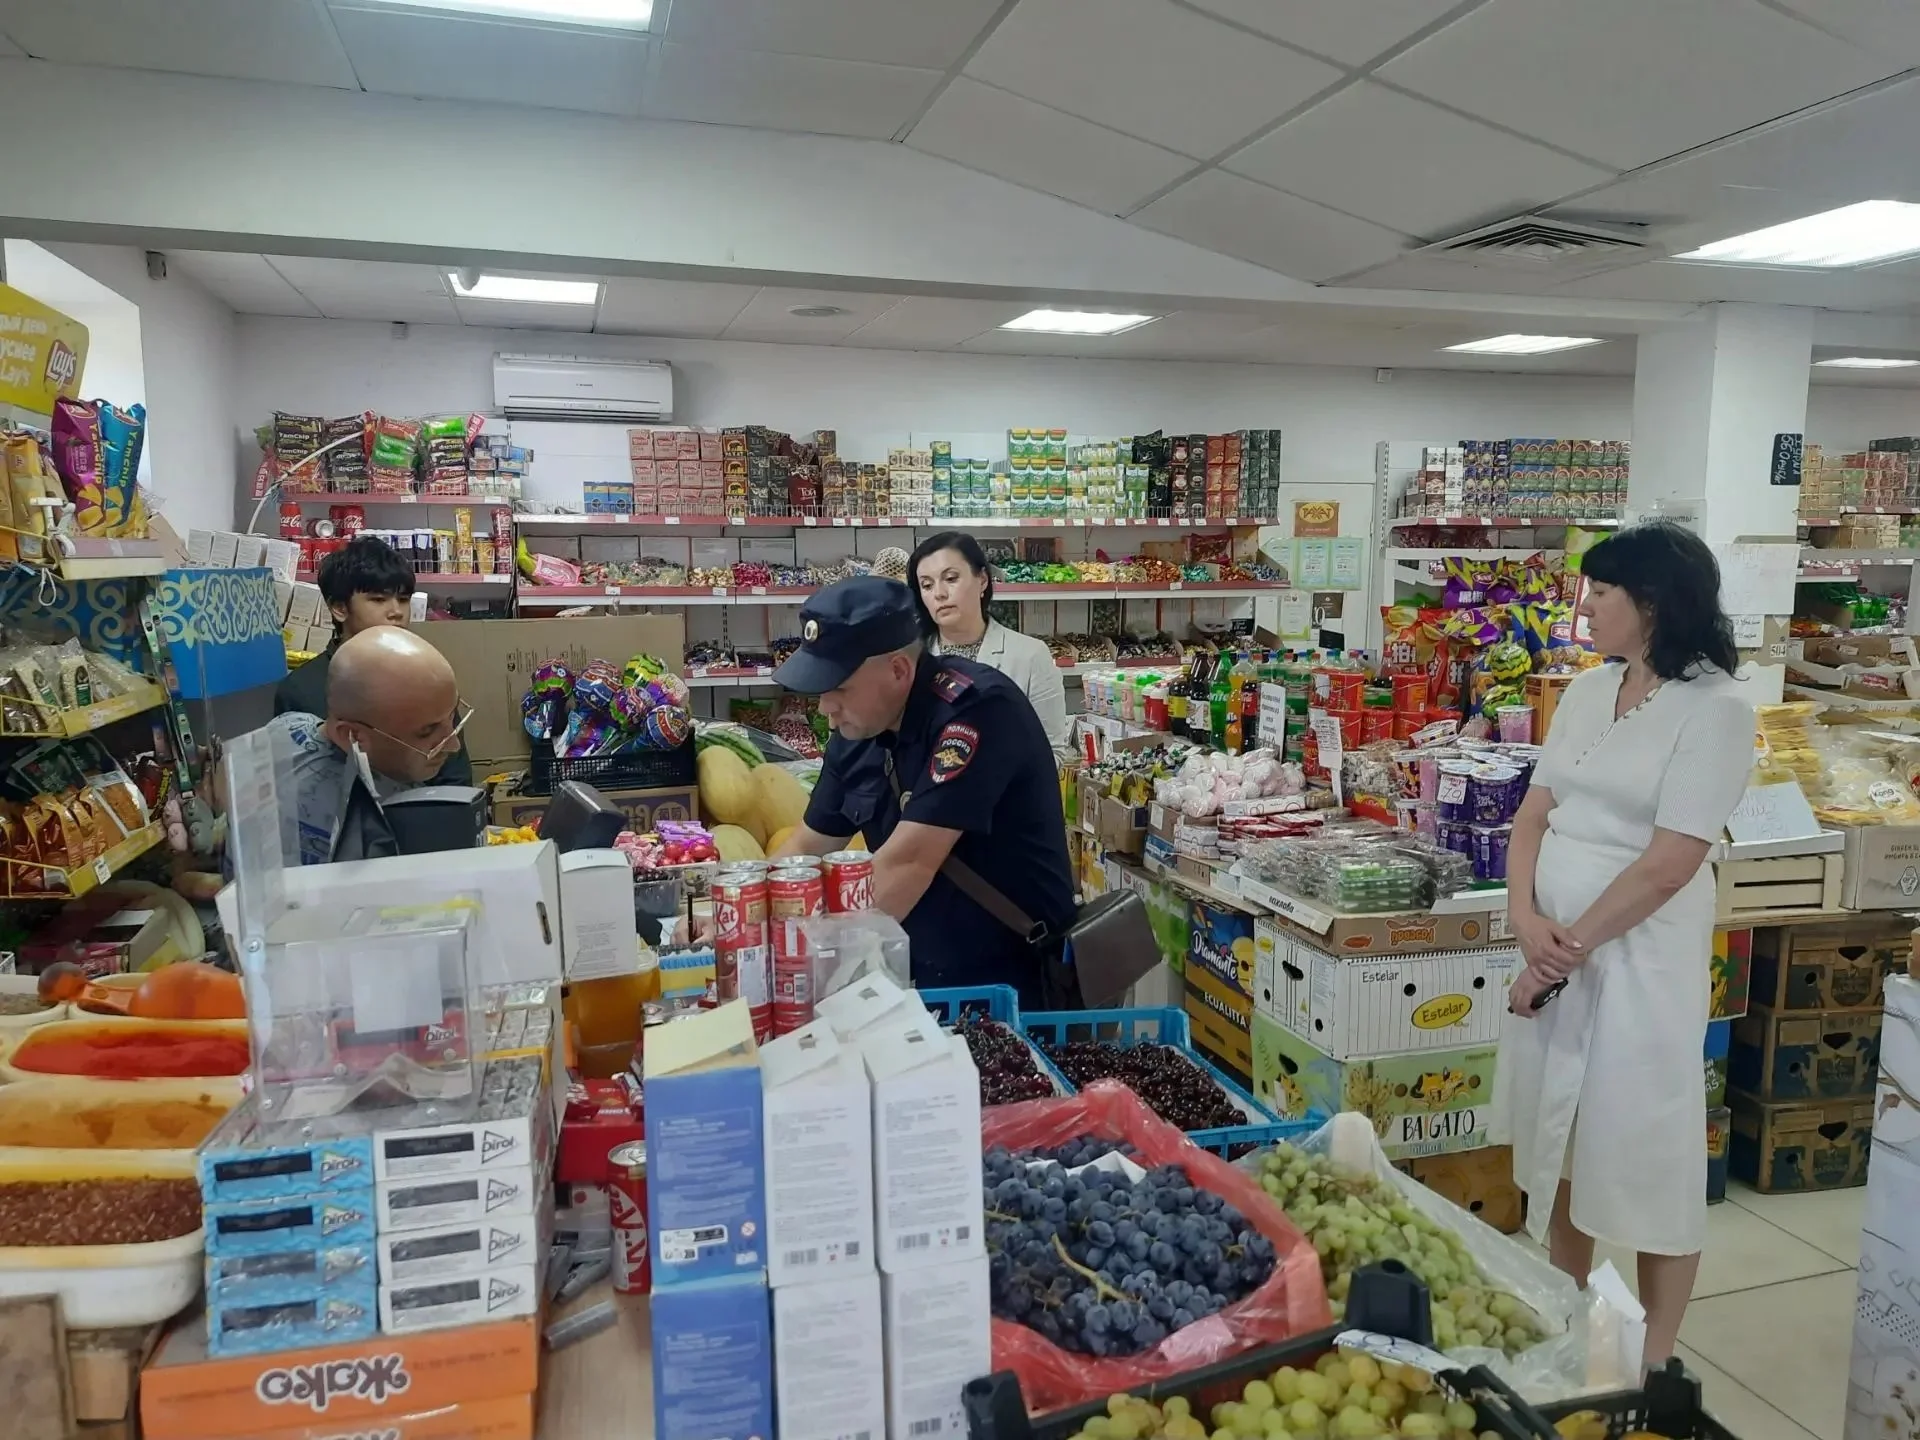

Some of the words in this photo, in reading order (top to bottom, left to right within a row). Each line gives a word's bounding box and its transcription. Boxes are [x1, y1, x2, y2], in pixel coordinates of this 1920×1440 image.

[46, 341, 77, 391] Lay's
[947, 725, 978, 741] ПОЛИЦИЯ
[941, 738, 971, 754] РОССИЯ
[1193, 929, 1238, 980] Diamante
[1362, 969, 1400, 983] Estelar
[1422, 1001, 1465, 1024] Estelar
[425, 1026, 457, 1043] Dirol
[483, 1135, 514, 1152] Dirol
[320, 1157, 356, 1172] Dirol
[487, 1184, 518, 1201] Dirol
[321, 1211, 357, 1226] Dirol
[489, 1233, 520, 1251] Dirol
[488, 1284, 520, 1301] Dirol
[261, 1355, 408, 1407] Жако
